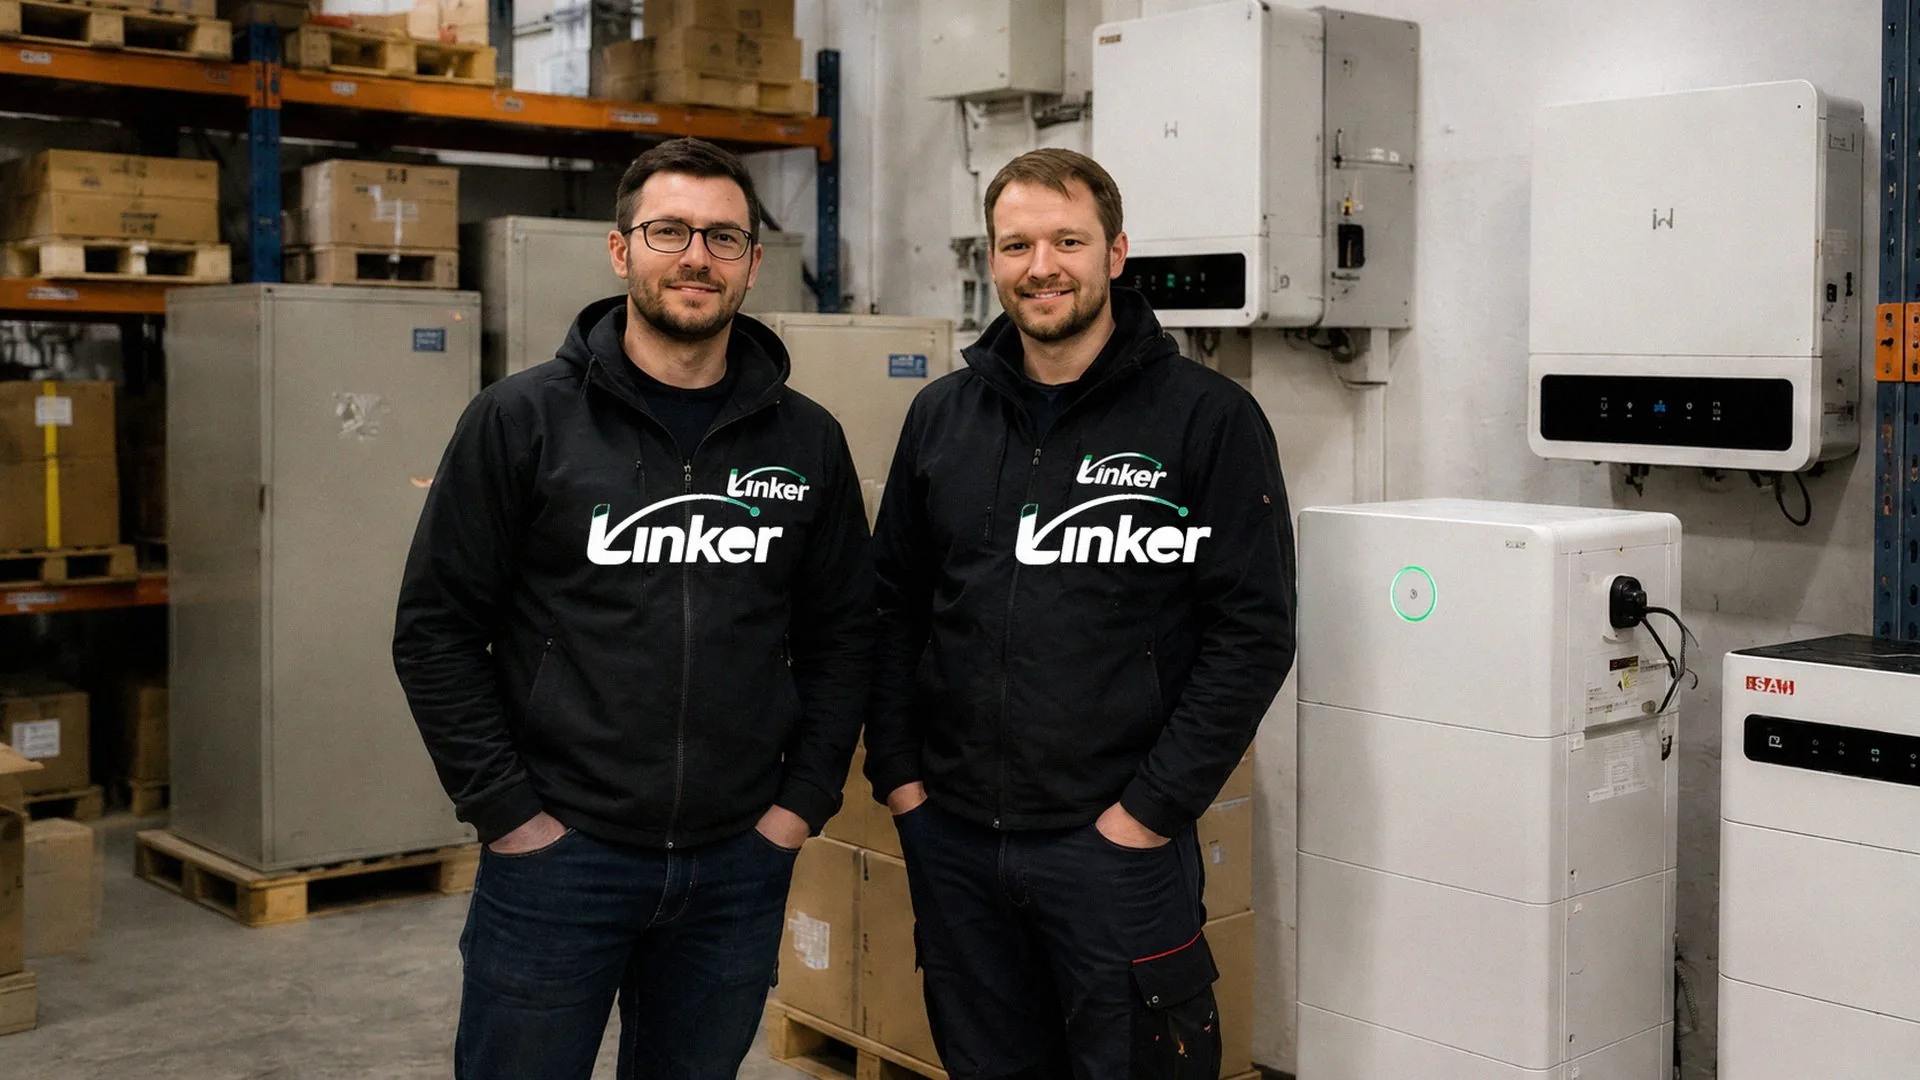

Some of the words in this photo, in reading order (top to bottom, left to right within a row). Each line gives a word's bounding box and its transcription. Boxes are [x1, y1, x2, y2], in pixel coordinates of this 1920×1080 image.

[726, 468, 810, 501] Linker
[1076, 453, 1168, 488] Linker
[587, 503, 784, 565] Linker
[1015, 503, 1212, 565] Linker
